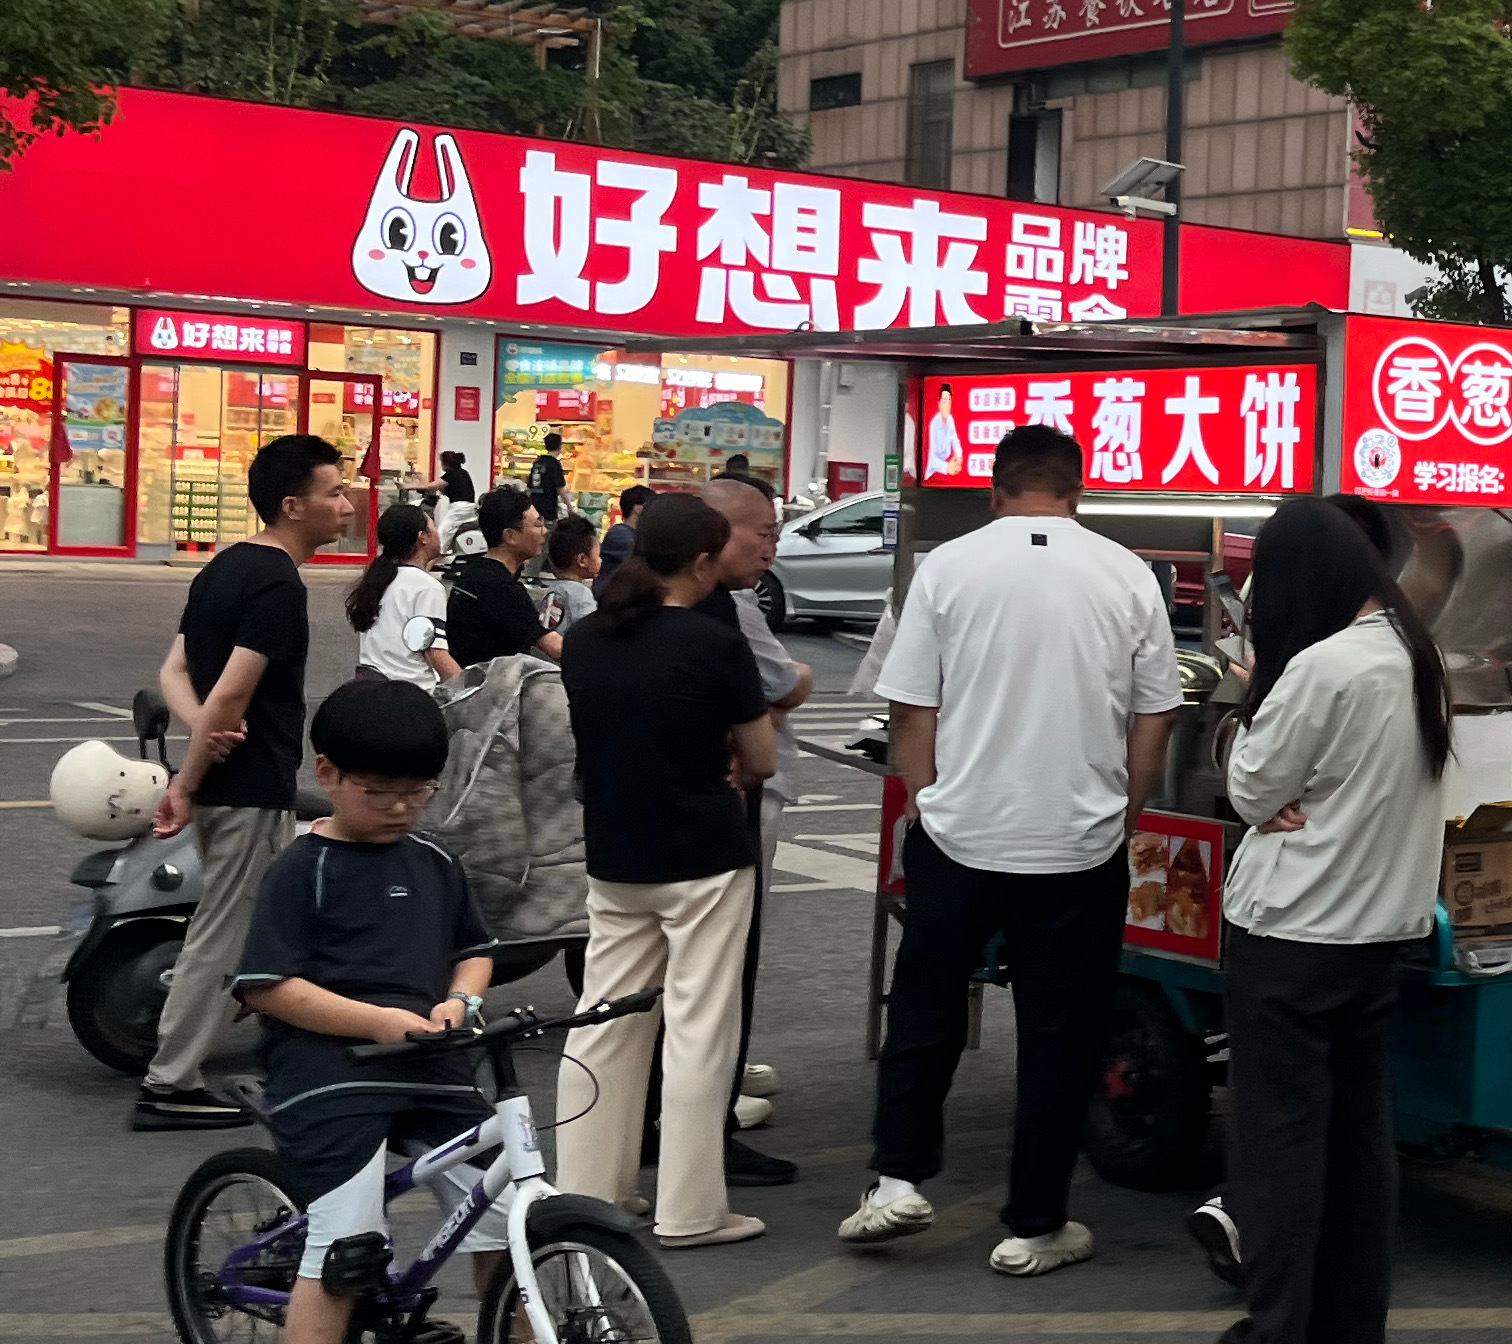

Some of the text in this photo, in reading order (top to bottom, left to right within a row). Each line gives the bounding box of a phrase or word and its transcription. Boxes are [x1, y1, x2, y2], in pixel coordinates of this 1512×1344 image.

[515, 148, 990, 332] 好想来
[1004, 212, 1129, 290] 品牌
[182, 321, 265, 353] 好想来
